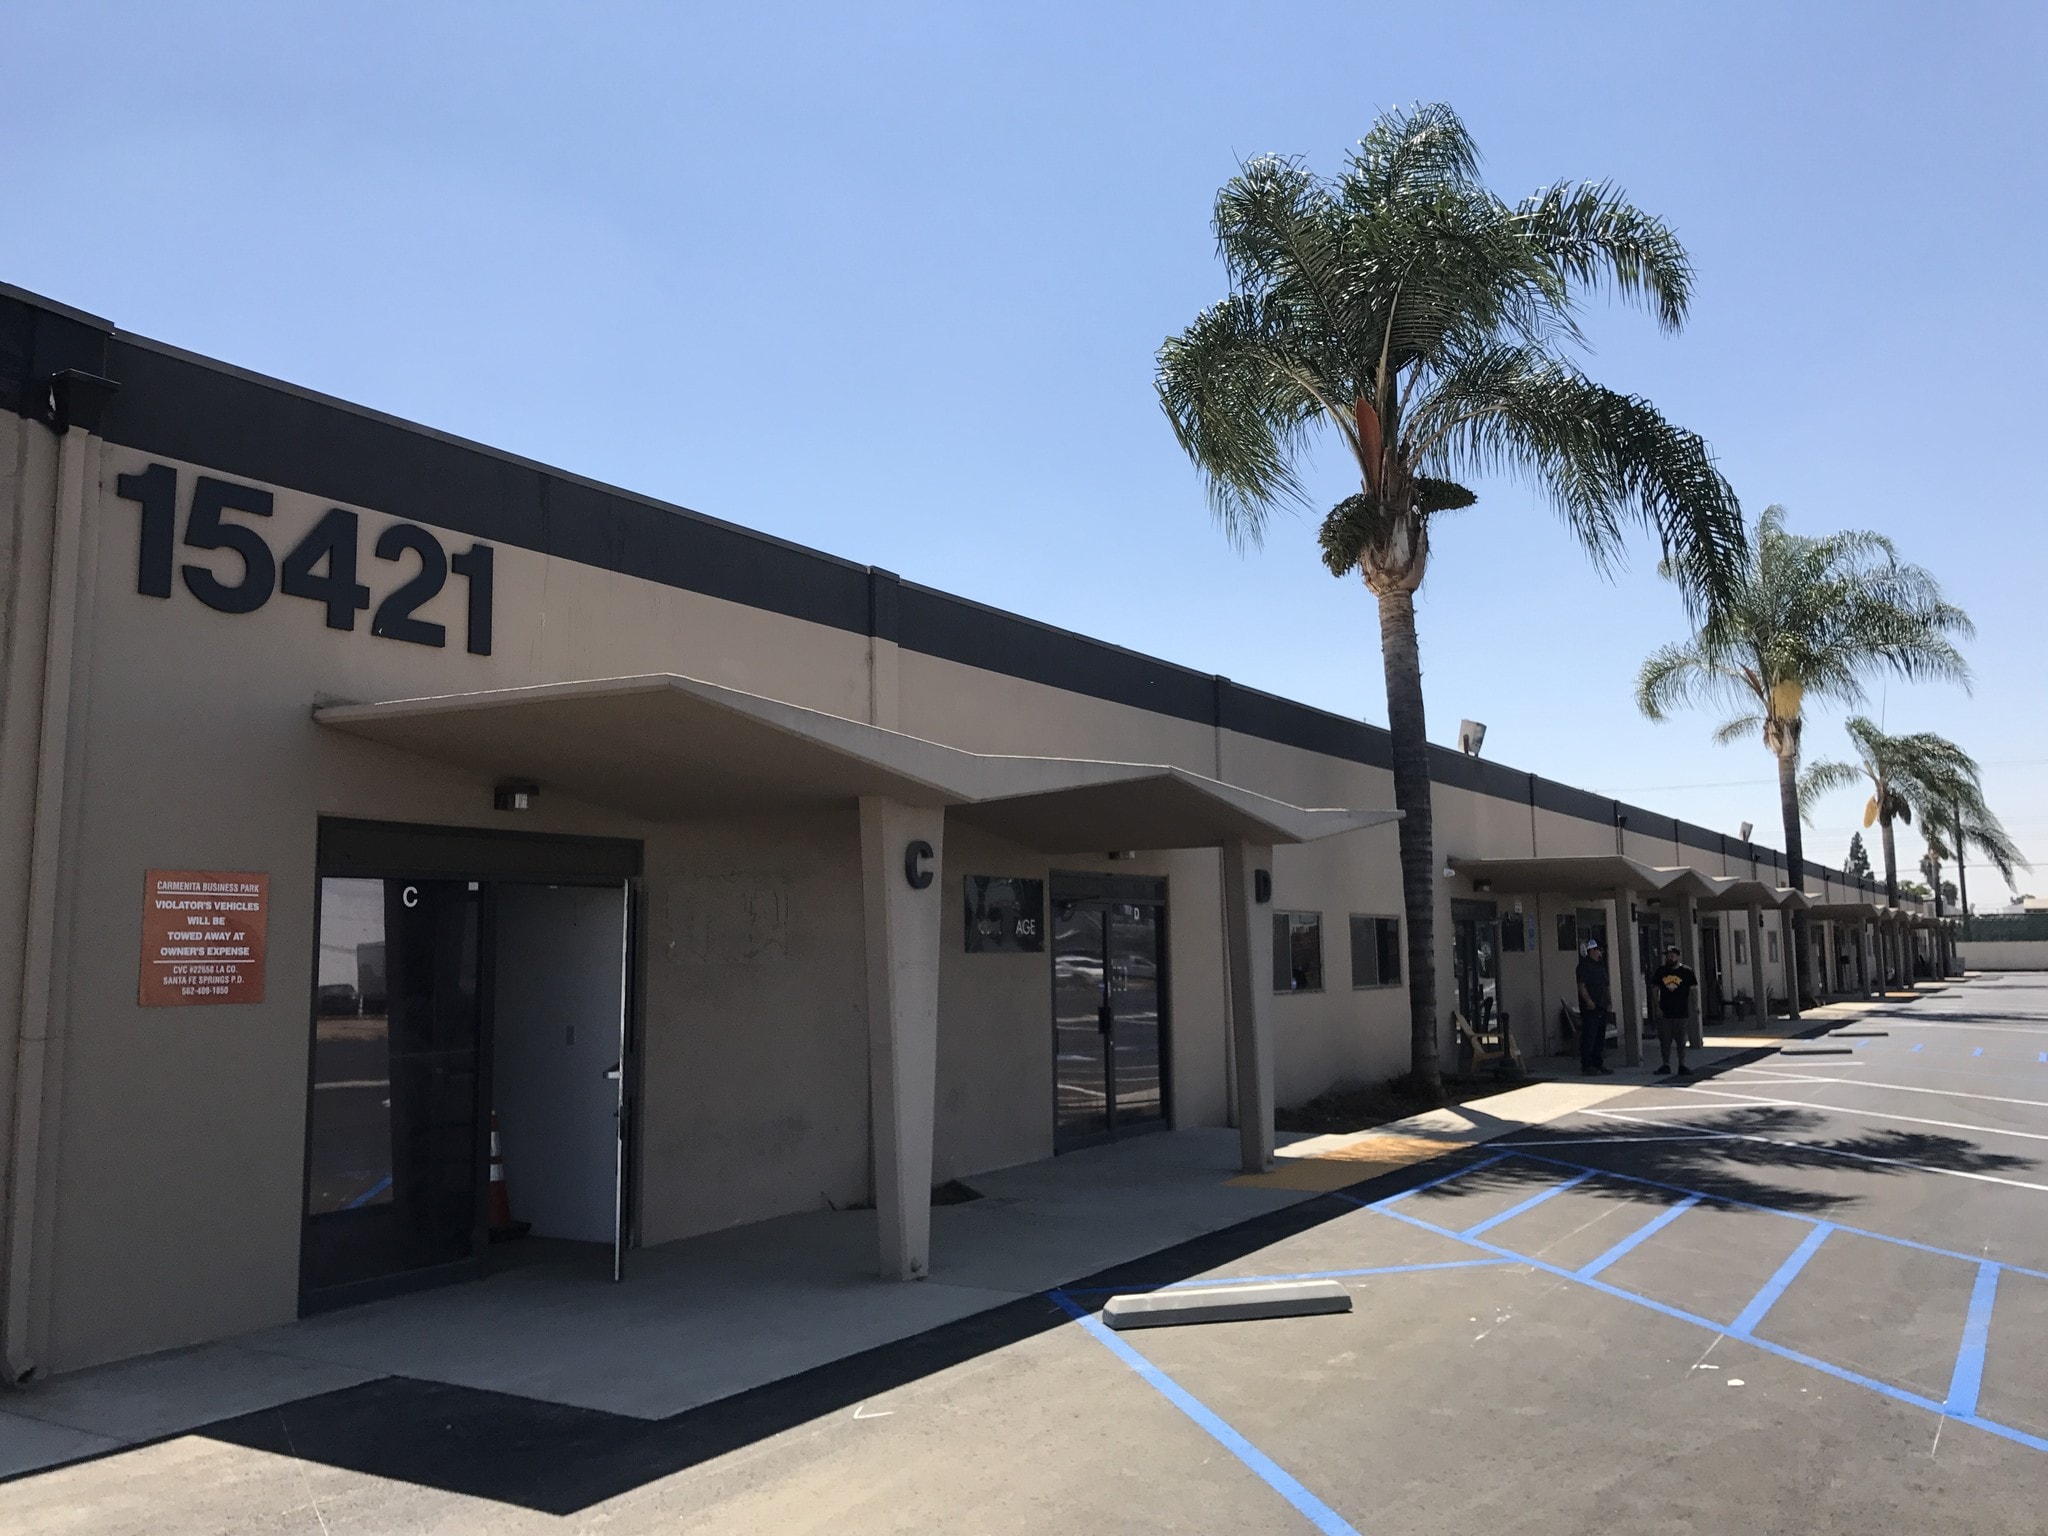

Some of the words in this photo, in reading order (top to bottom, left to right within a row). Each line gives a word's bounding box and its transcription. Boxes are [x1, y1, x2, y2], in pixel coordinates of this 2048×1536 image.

[117, 463, 493, 656] 15421
[904, 840, 934, 889] C
[157, 880, 201, 891] CARMENITA
[202, 882, 238, 892] BUSINESS
[240, 883, 259, 893] PARK
[1254, 869, 1272, 904] D
[402, 886, 418, 908] C
[155, 900, 212, 910] VIOLATOR'S
[214, 901, 259, 911] VEHICLES
[1133, 907, 1140, 921] D
[187, 916, 210, 926] WILL
[212, 916, 225, 926] BE
[167, 932, 203, 941] TOWED
[204, 932, 231, 941] AWAY
[233, 932, 245, 941] AT
[160, 947, 205, 956] OWNER'S
[206, 947, 250, 956] EXPENSE
[173, 965, 188, 974] CVC
[215, 965, 225, 974] LA
[163, 976, 186, 985] SANTA
[188, 976, 197, 985] FE
[198, 976, 229, 984] SPRINGS
